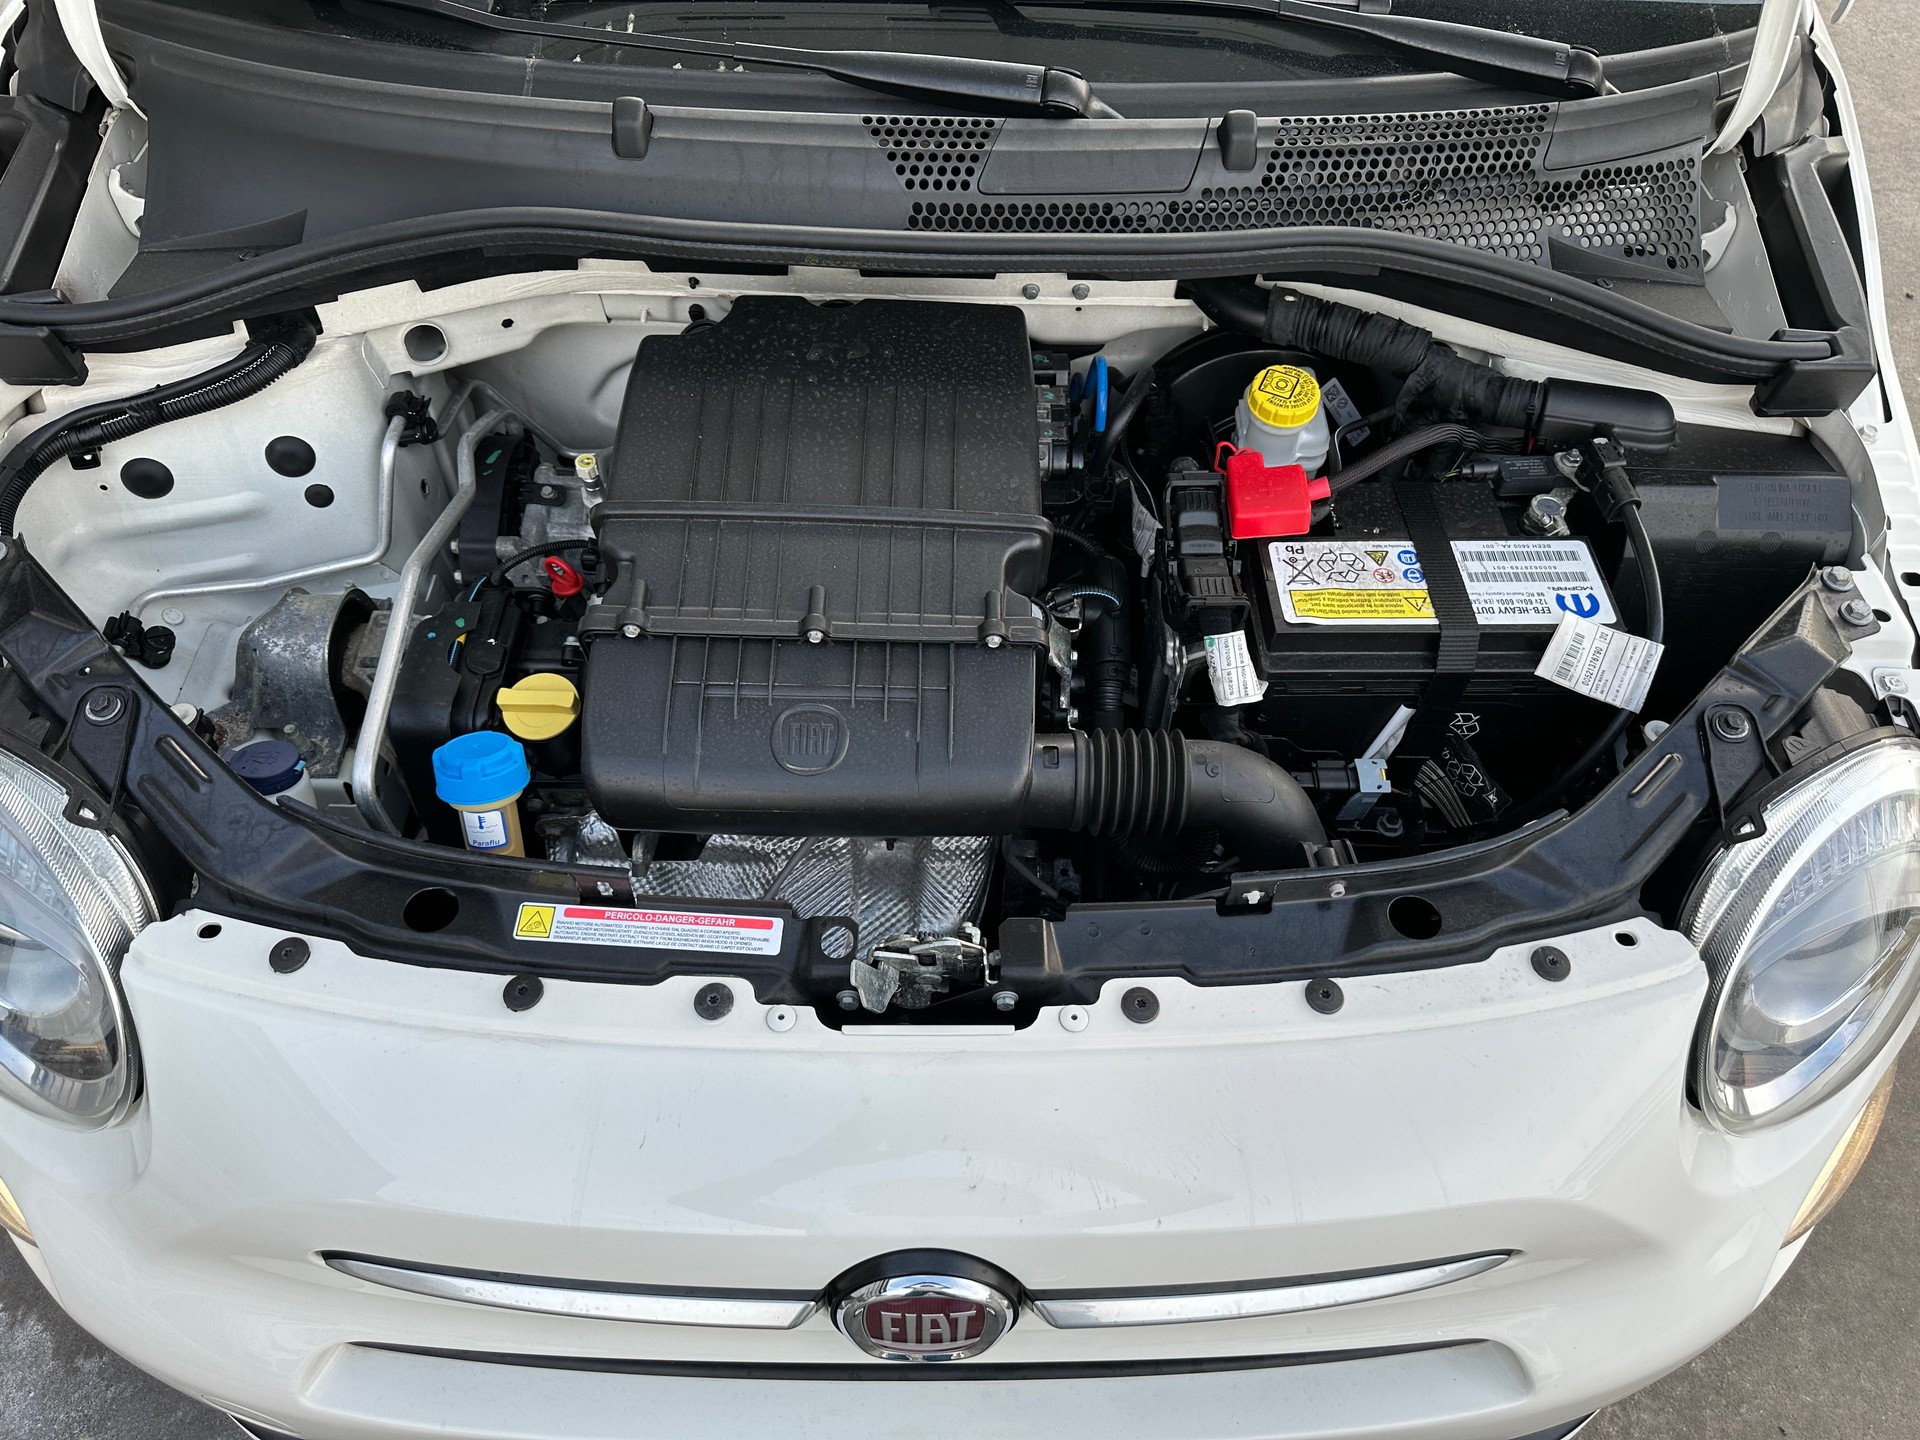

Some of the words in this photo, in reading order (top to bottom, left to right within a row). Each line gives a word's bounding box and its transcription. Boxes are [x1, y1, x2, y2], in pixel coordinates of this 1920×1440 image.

[1768, 512, 1782, 521] AND
[1285, 545, 1304, 554] Pb
[1498, 606, 1551, 614] EFB-HEAVY
[788, 722, 834, 755] FIAT
[472, 839, 500, 847] Paraflu
[604, 911, 736, 927] PERICOLO-DANGER-GEFAHR
[881, 1310, 977, 1344] FIAT
